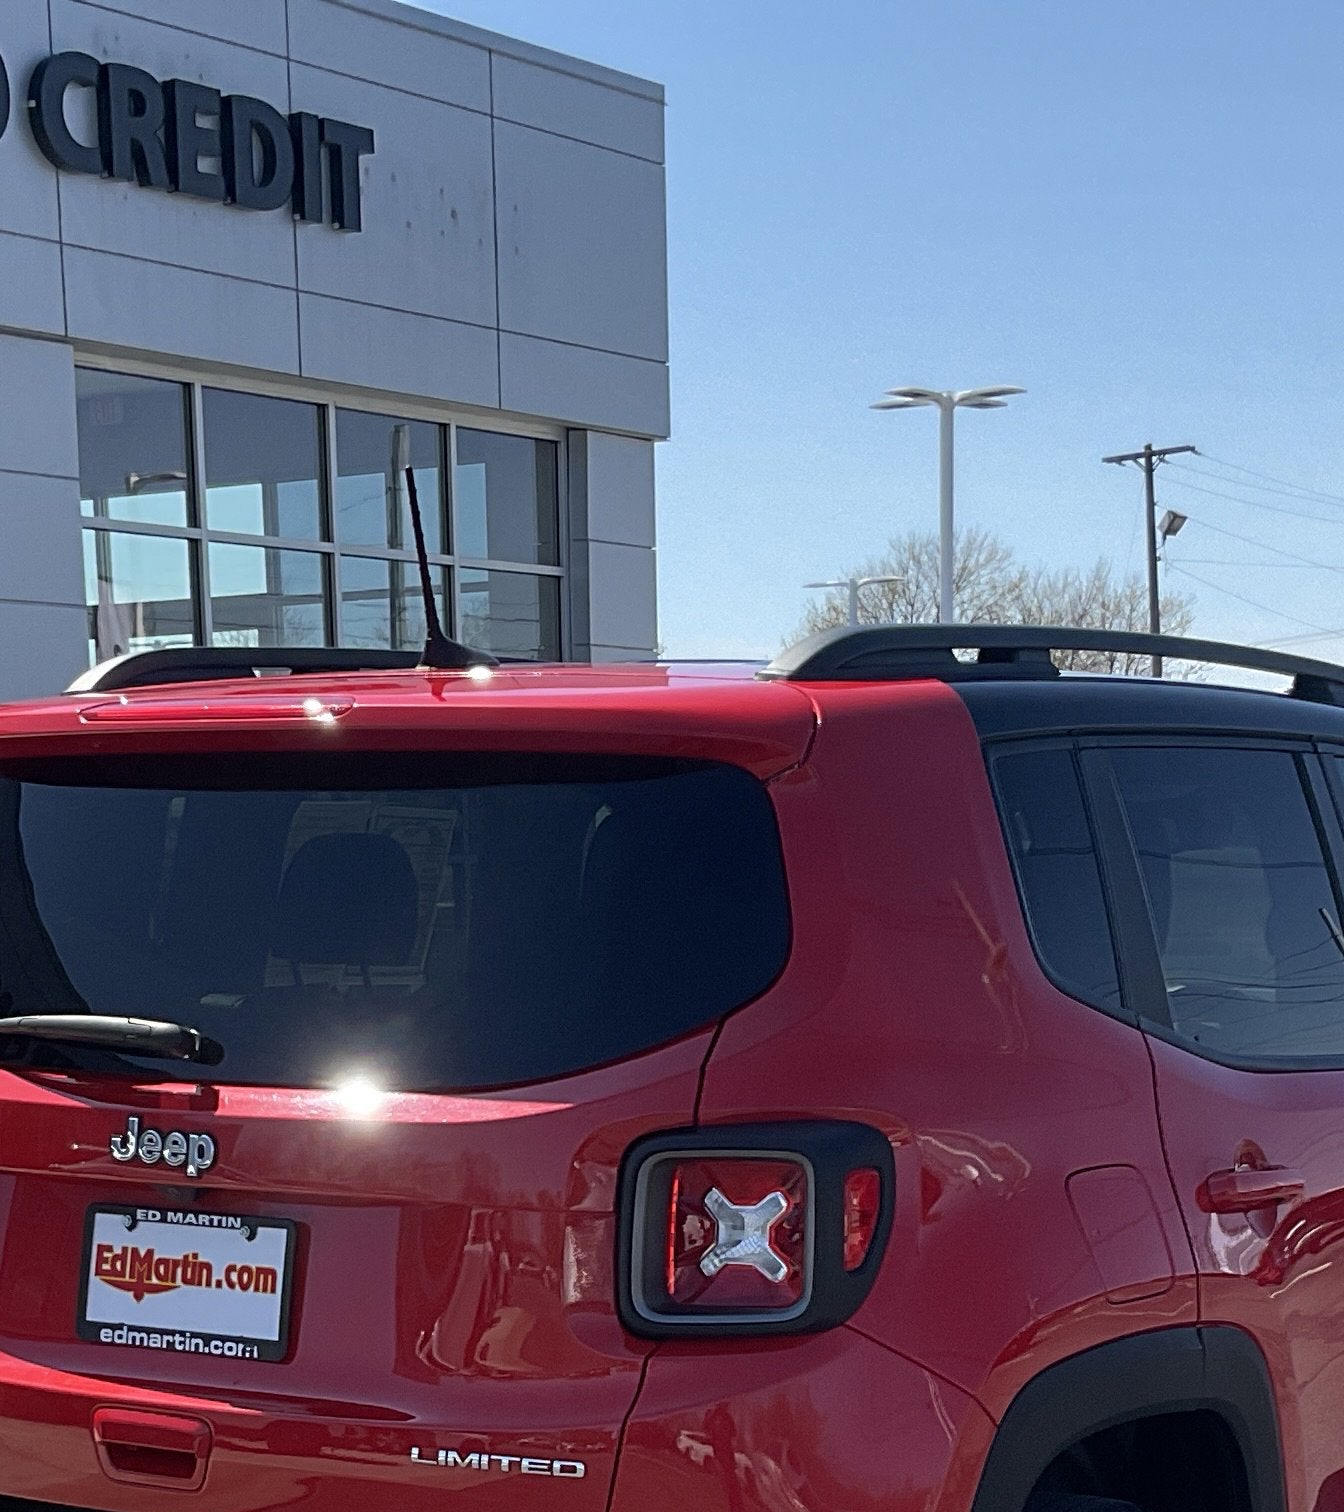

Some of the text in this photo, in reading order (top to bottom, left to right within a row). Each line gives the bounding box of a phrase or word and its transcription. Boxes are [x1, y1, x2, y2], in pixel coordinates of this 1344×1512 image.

[27, 51, 375, 233] CREDIT
[110, 1115, 216, 1177] Jeep
[135, 1208, 243, 1229] ED MARTIN
[94, 1243, 278, 1296] EdMartin.com
[410, 1446, 586, 1479] LIMITED
